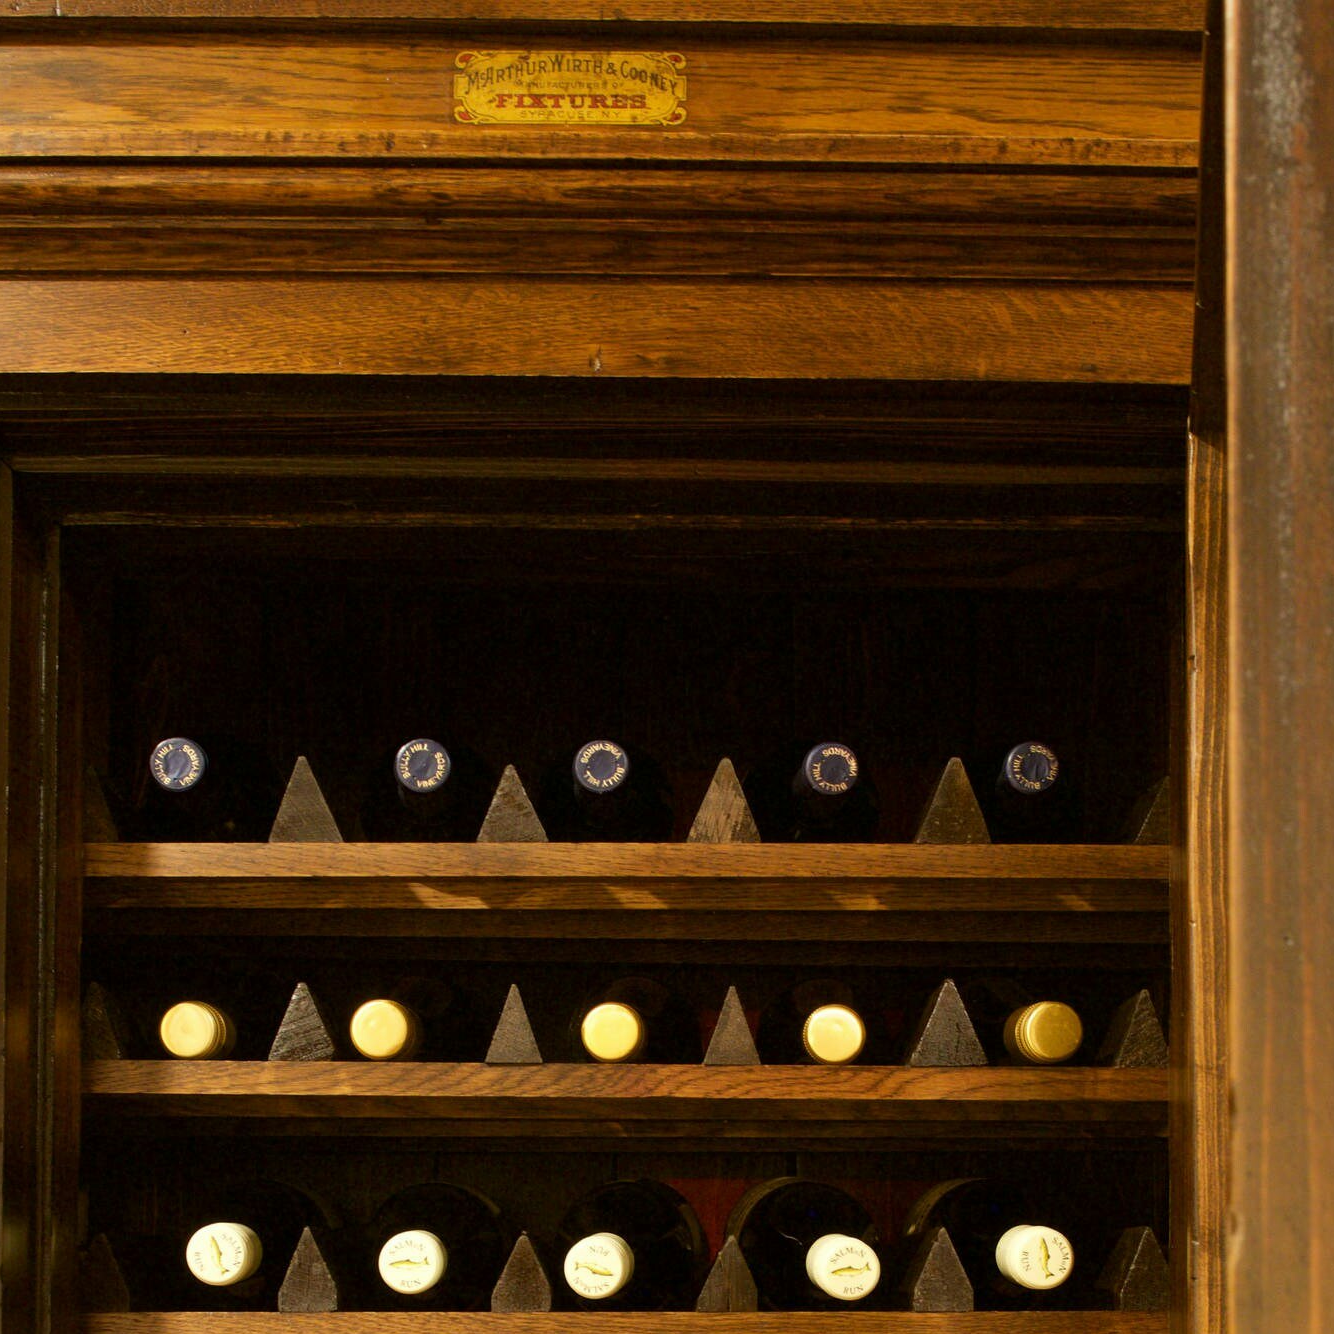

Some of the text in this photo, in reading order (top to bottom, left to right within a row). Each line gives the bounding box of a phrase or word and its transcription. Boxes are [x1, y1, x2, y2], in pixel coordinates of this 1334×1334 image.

[547, 54, 603, 74] WIRTH
[607, 62, 618, 76] &
[620, 61, 677, 96] COONEY
[495, 93, 647, 109] FIXTURES
[154, 743, 174, 785] BULLY HILL
[179, 744, 199, 786] VINEYARDS
[400, 743, 429, 779] BULLY HILL
[416, 752, 445, 788] VINEYARDS
[580, 743, 622, 764] VINEYARDS
[583, 767, 625, 788] BULLY HILL
[818, 781, 848, 792] BULLY
